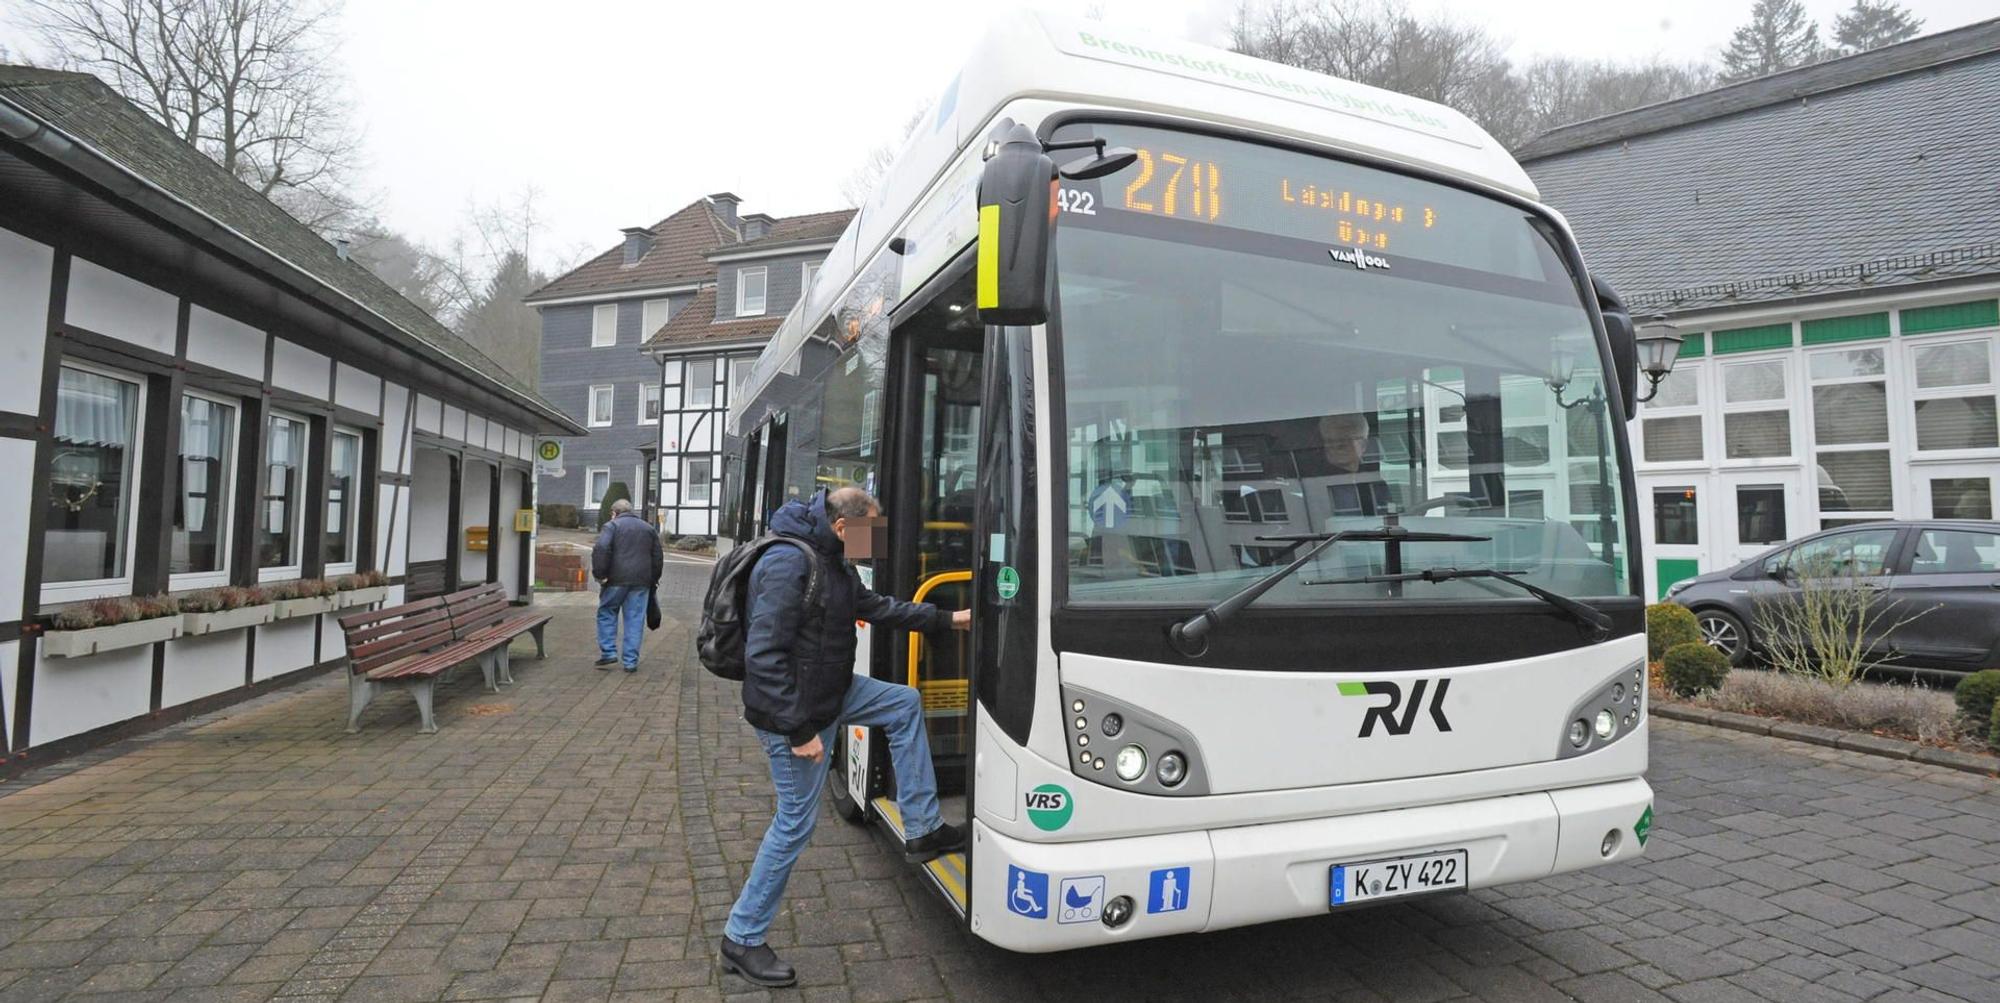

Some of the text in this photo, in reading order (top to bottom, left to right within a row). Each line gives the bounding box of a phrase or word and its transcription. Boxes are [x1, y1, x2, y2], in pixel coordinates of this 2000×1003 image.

[1079, 31, 1448, 130] Brennstoffzellen-Hybrid-Bus
[1057, 188, 1096, 216] 422
[1025, 792, 1062, 809] VRS
[1355, 858, 1457, 896] K ZY 422
